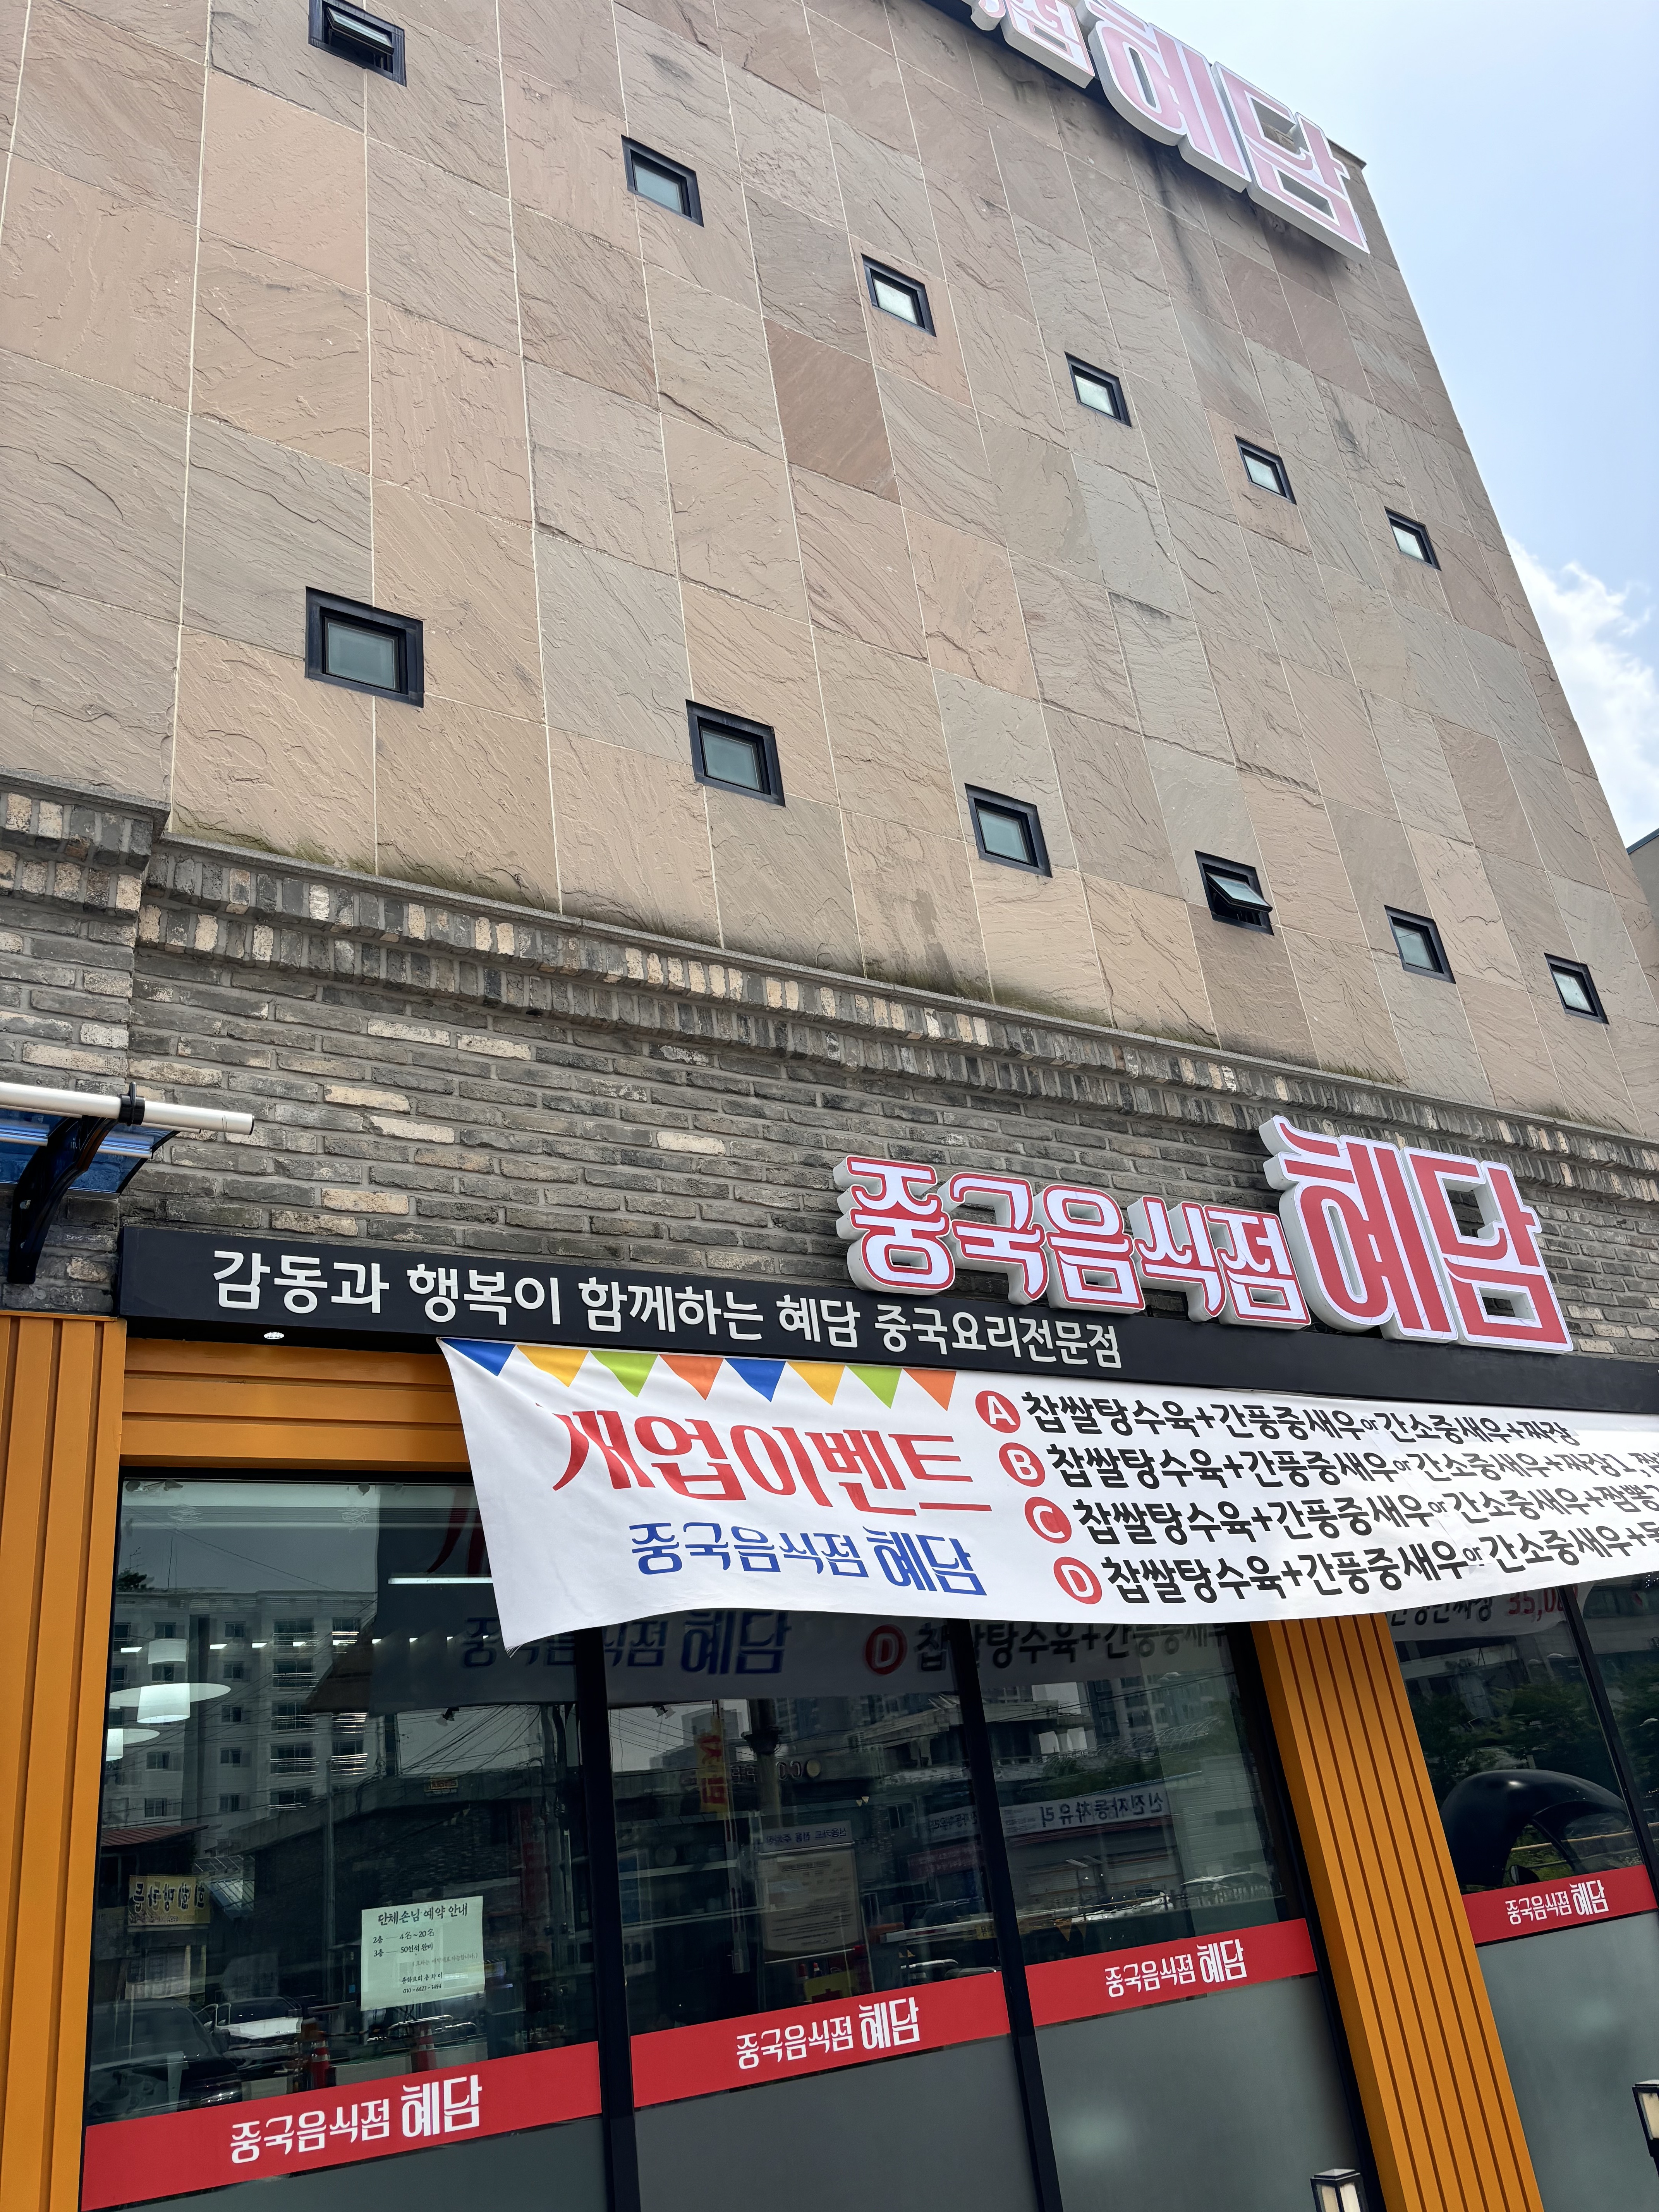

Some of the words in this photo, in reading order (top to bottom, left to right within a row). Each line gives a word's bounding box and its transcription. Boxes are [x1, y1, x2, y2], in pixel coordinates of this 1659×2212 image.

[1087, 0, 1371, 256] 혜담
[840, 1156, 1312, 1328] 중국음식점
[1266, 1115, 1575, 1352] 혜담
[213, 1250, 389, 1314] 감동과
[407, 1263, 561, 1326] 행복이
[579, 1277, 764, 1341] 함께하는
[776, 1294, 860, 1348] 혜담
[874, 1304, 1122, 1369] 중국요리전문점
[984, 1393, 1018, 1428] A
[536, 1402, 992, 1516] 개업이벤트
[1005, 1448, 1040, 1481] B
[1032, 1505, 1067, 1540] C
[630, 1522, 869, 1578] 중국음식점
[863, 1526, 987, 1595] 혜담
[1063, 1562, 1097, 1599] D
[378, 1910, 398, 1926] 단체
[399, 1908, 420, 1923] 손님
[423, 1905, 445, 1920] 예약
[448, 1902, 467, 1917] 안내
[1505, 1890, 1572, 1925] 중국음식점
[1569, 1879, 1609, 1915] 혜담
[1104, 1954, 1196, 1998] 중국음식점
[1196, 1938, 1247, 1984] 혜담
[736, 2016, 853, 2070] 중국음식점
[859, 1996, 920, 2049] 혜담
[230, 2098, 390, 2164] 중국음식점
[402, 2074, 482, 2138] 혜담
